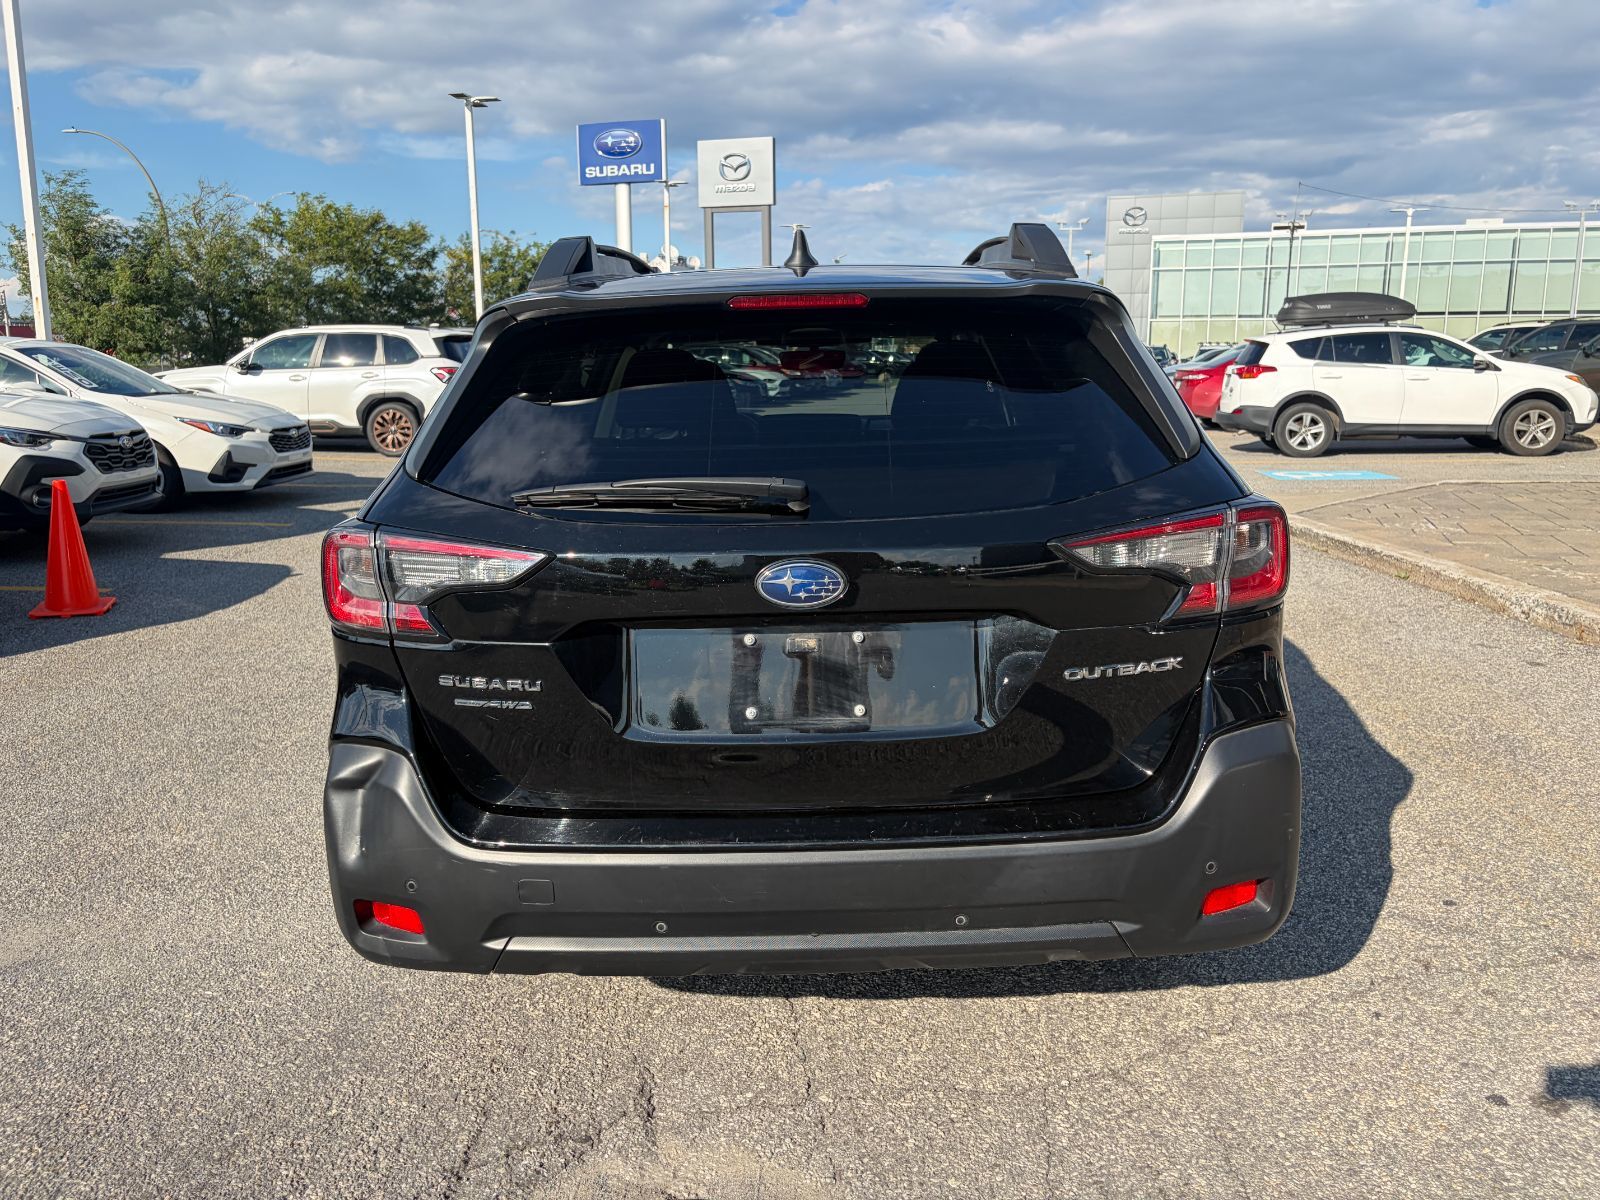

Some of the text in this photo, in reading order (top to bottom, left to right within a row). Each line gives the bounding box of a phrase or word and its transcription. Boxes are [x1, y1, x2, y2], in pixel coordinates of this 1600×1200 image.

[585, 163, 655, 178] SUBARU
[715, 183, 755, 193] mazda
[1063, 656, 1184, 681] OUTBACK
[438, 674, 543, 692] SUBARU
